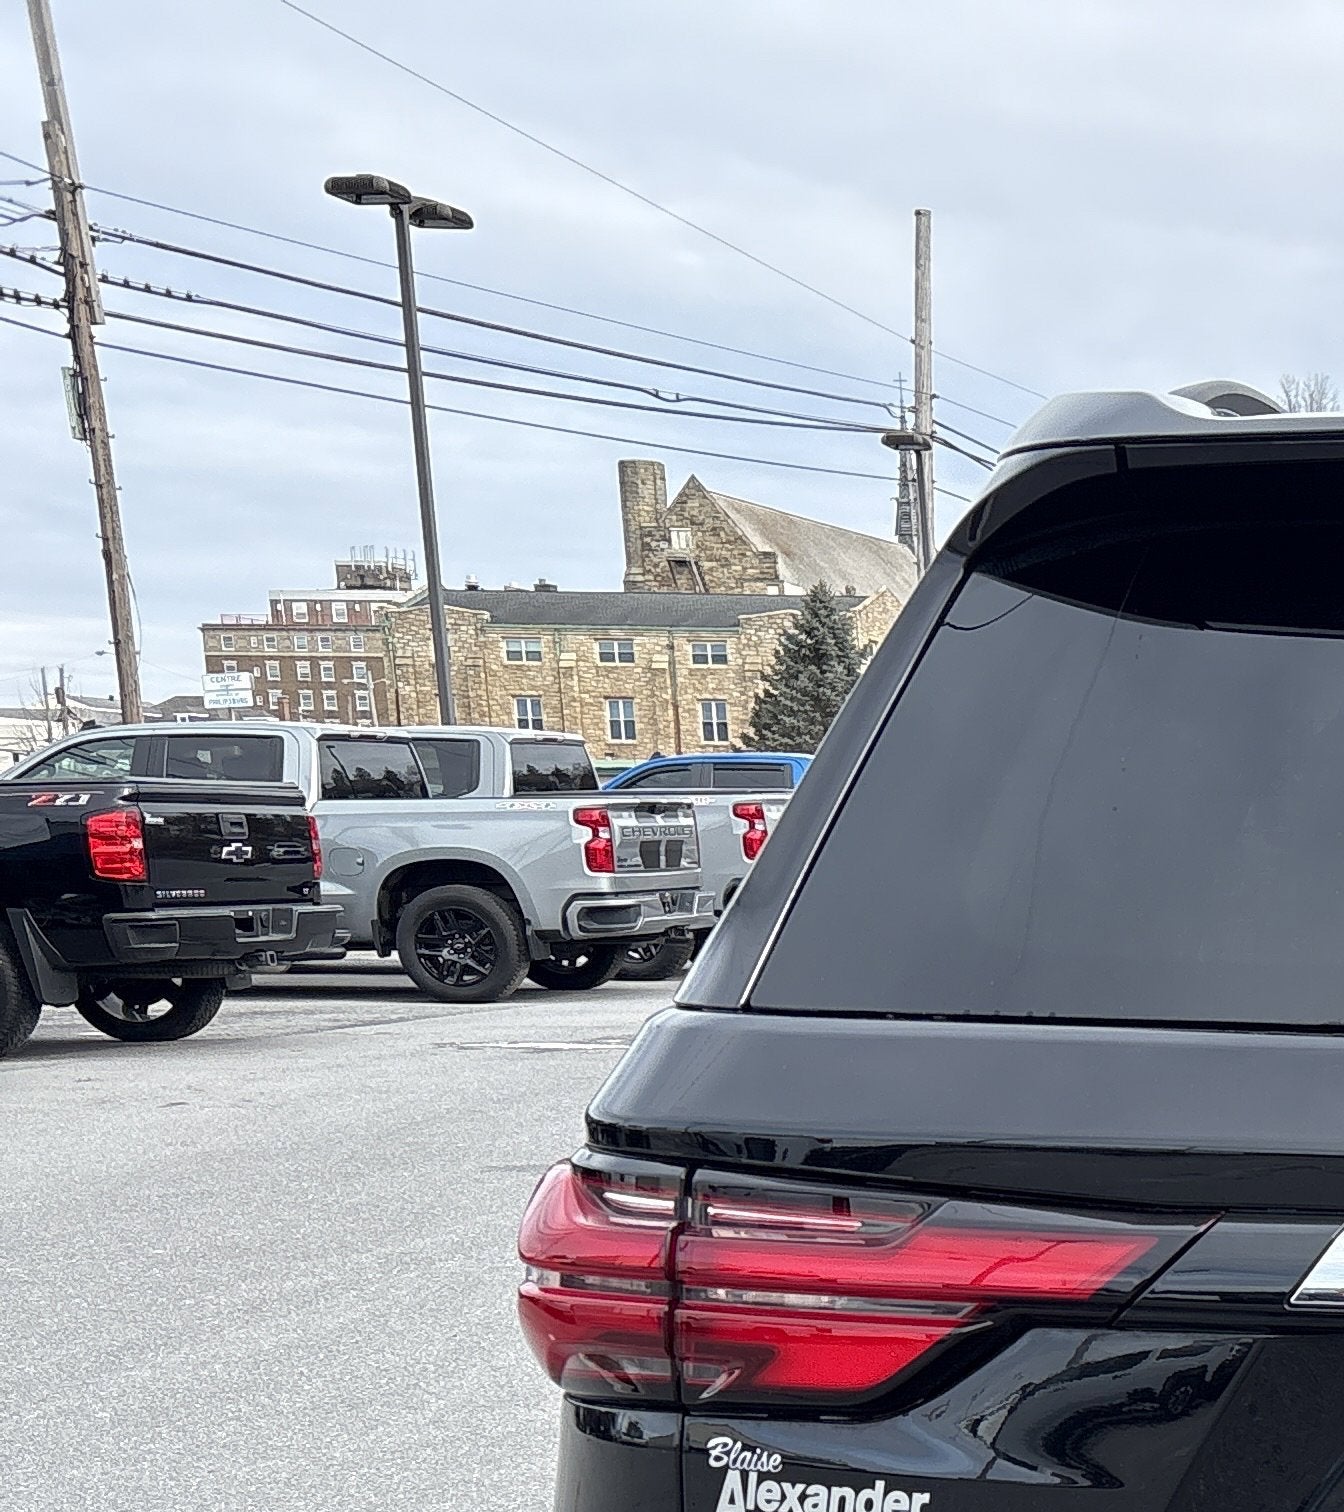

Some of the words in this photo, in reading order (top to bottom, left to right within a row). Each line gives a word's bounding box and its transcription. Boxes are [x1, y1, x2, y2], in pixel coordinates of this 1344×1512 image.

[210, 674, 243, 684] CENTRE
[27, 793, 91, 806] Z71
[706, 1436, 783, 1473] Blaise
